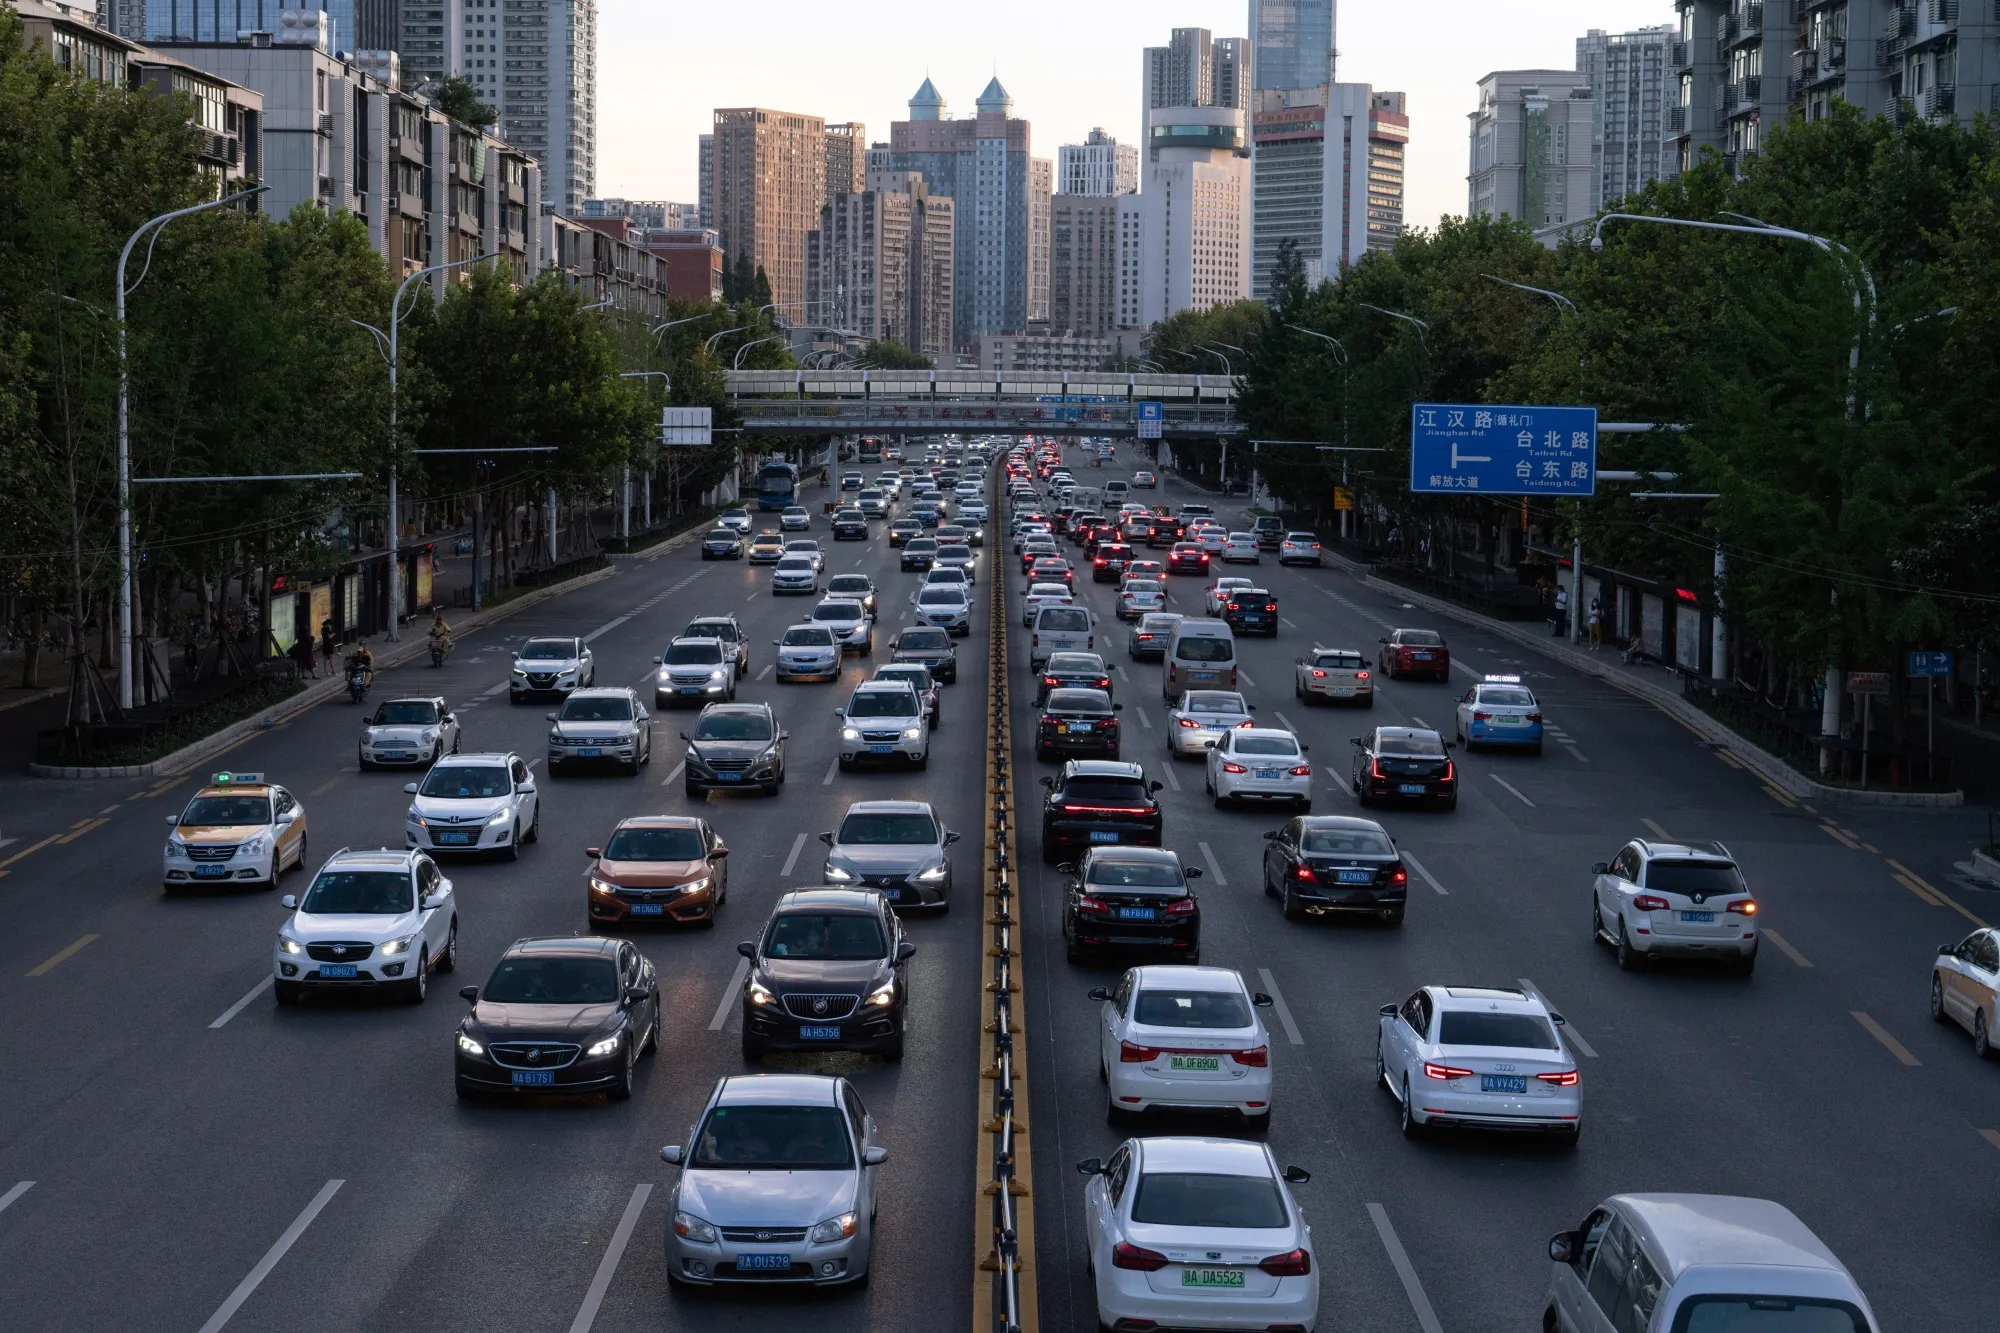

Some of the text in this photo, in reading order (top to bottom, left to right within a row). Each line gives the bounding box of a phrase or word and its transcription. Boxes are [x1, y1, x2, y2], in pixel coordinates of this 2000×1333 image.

[1419, 410, 1493, 428] 江汉路
[1425, 429, 1469, 437] Jianghan
[1516, 430, 1590, 449] 台北路
[1529, 449, 1558, 457] Taibei
[1515, 459, 1589, 479] 台东路
[1429, 475, 1479, 488] 解放大道
[1523, 479, 1562, 488] Taidong
